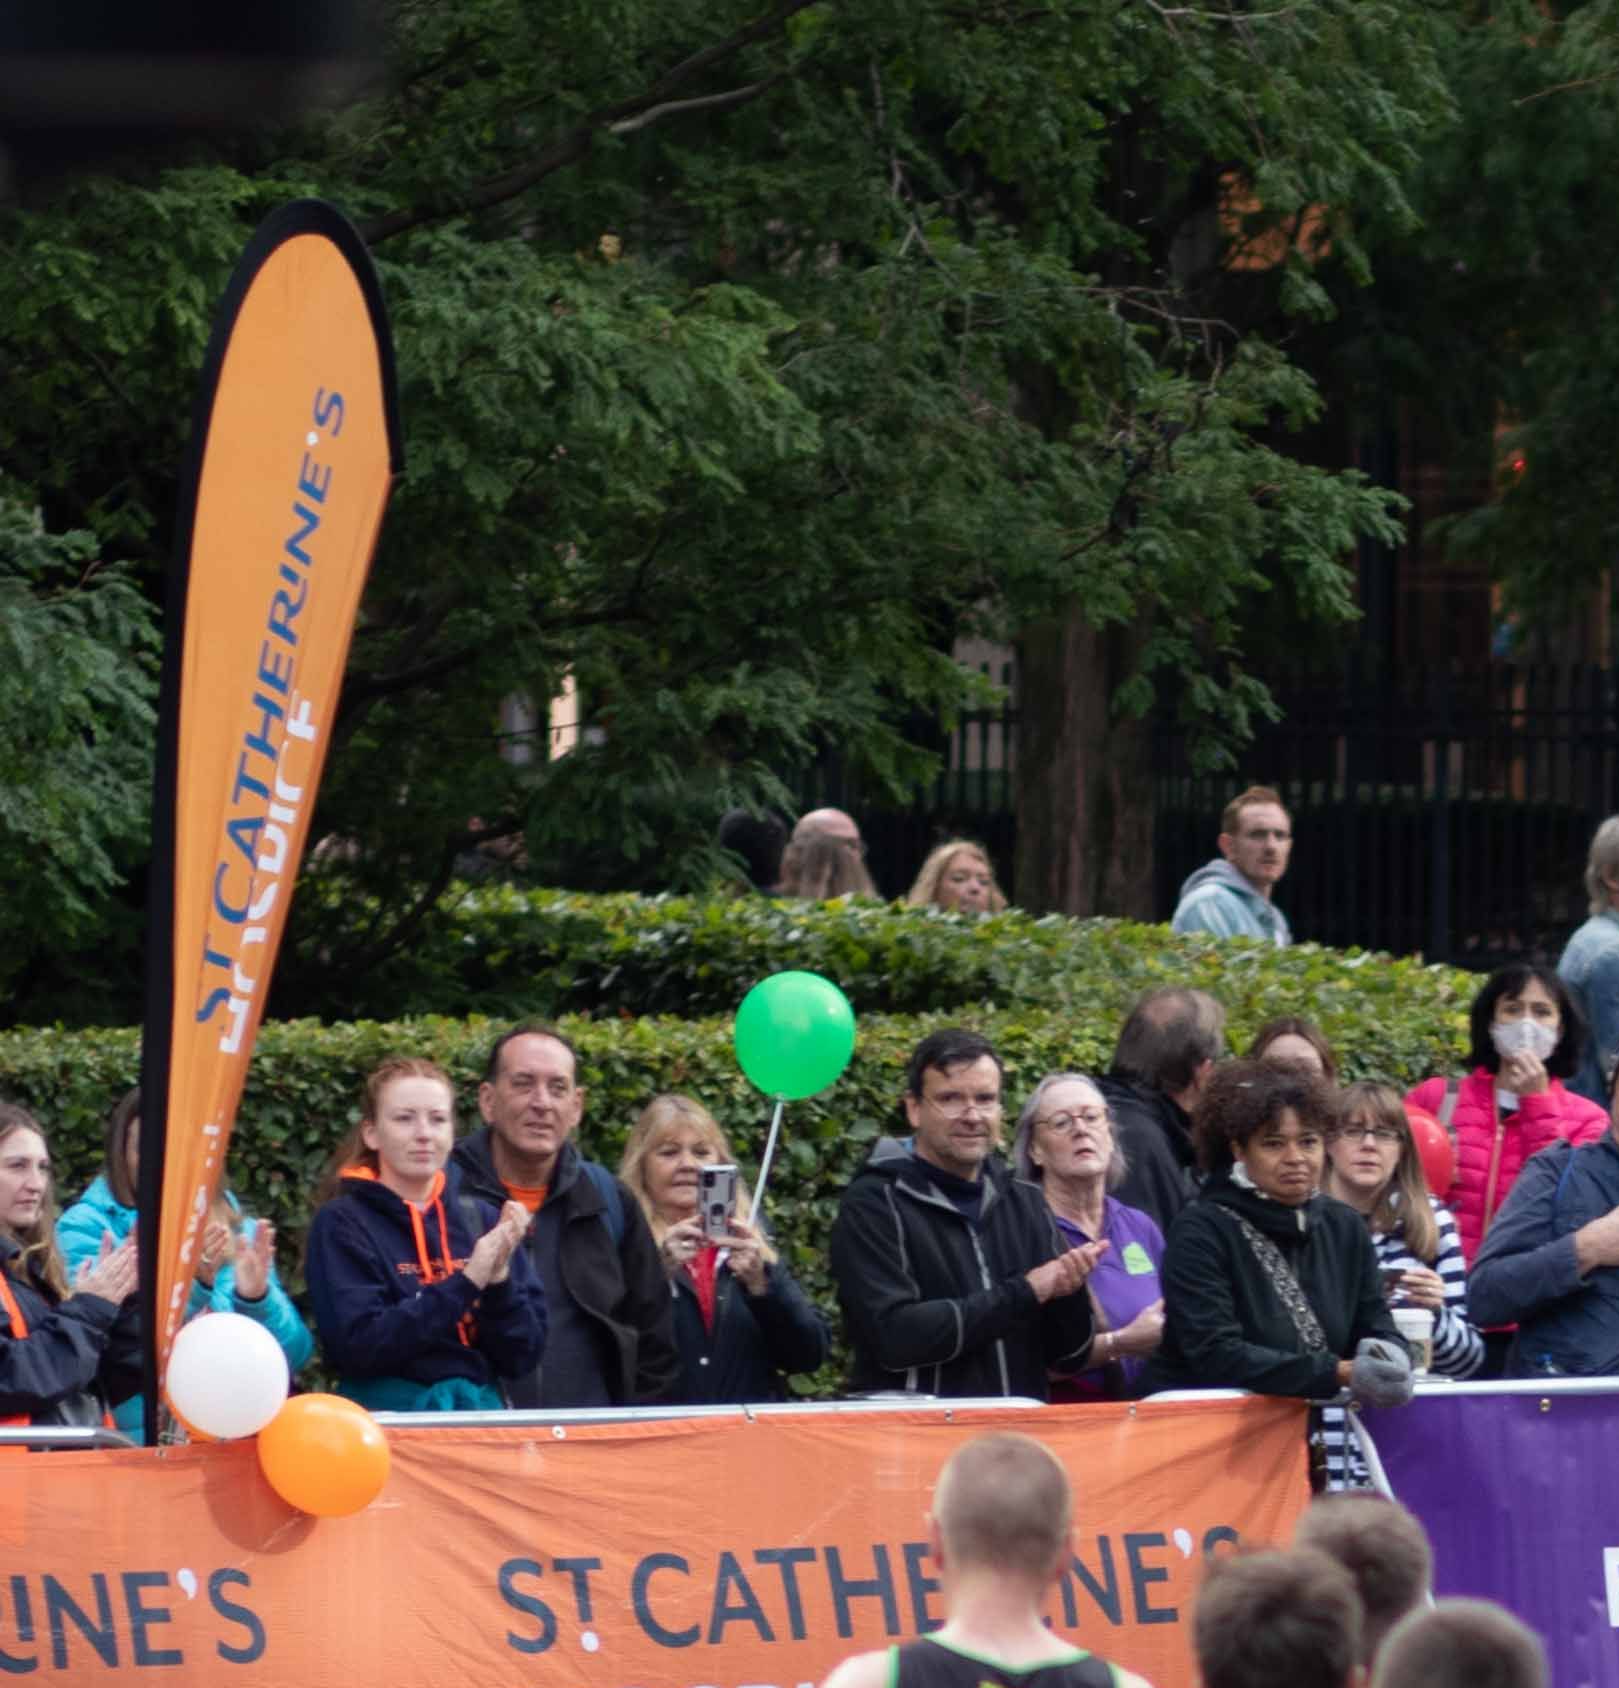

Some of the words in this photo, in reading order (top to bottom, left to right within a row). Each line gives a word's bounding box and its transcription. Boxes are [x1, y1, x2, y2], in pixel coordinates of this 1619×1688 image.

[213, 386, 345, 924] CATHERINE'S
[0, 1567, 268, 1674] INE'S
[631, 1526, 1240, 1648] CATHENE'
